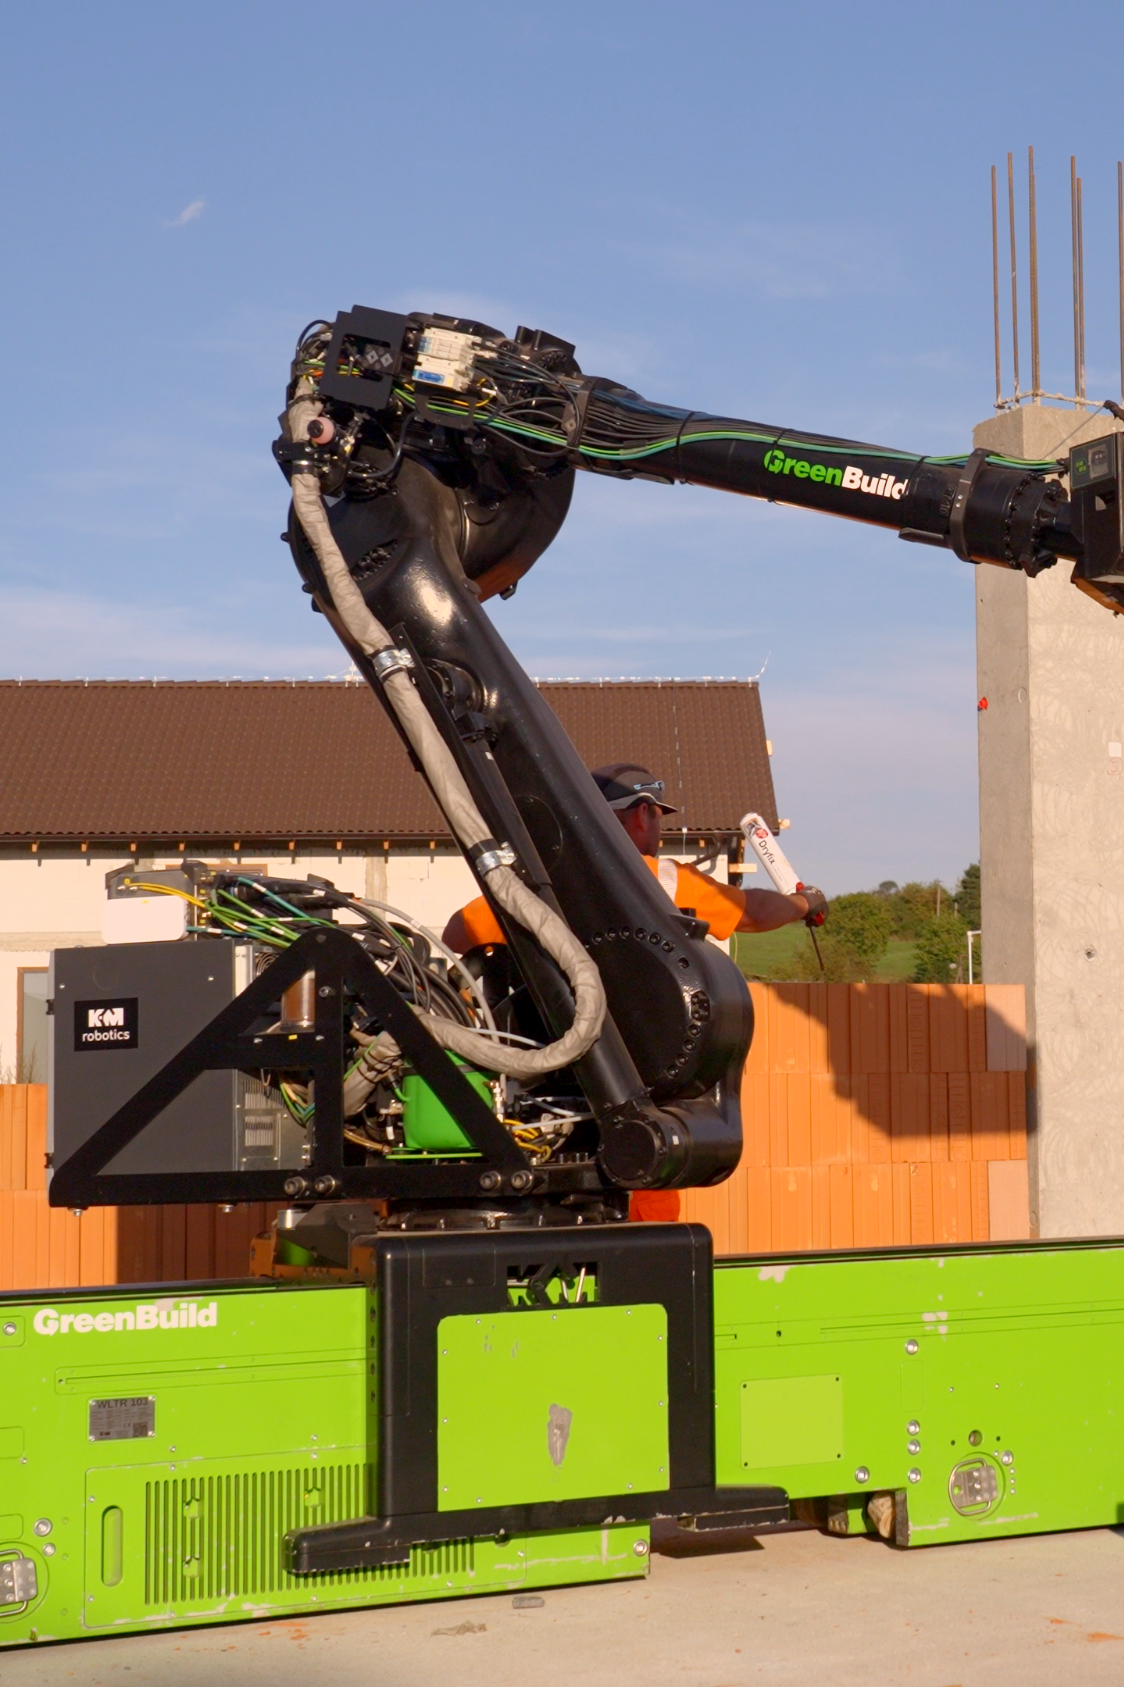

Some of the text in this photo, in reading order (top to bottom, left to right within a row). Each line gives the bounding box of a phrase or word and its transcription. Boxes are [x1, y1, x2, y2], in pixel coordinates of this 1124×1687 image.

[763, 450, 909, 500] GreenBuild
[758, 840, 776, 865] Dryfix
[88, 1008, 124, 1028] KM
[82, 1029, 130, 1042] robotics
[33, 1302, 217, 1336] GreenBuild
[97, 1398, 148, 1409] WLTR 103
